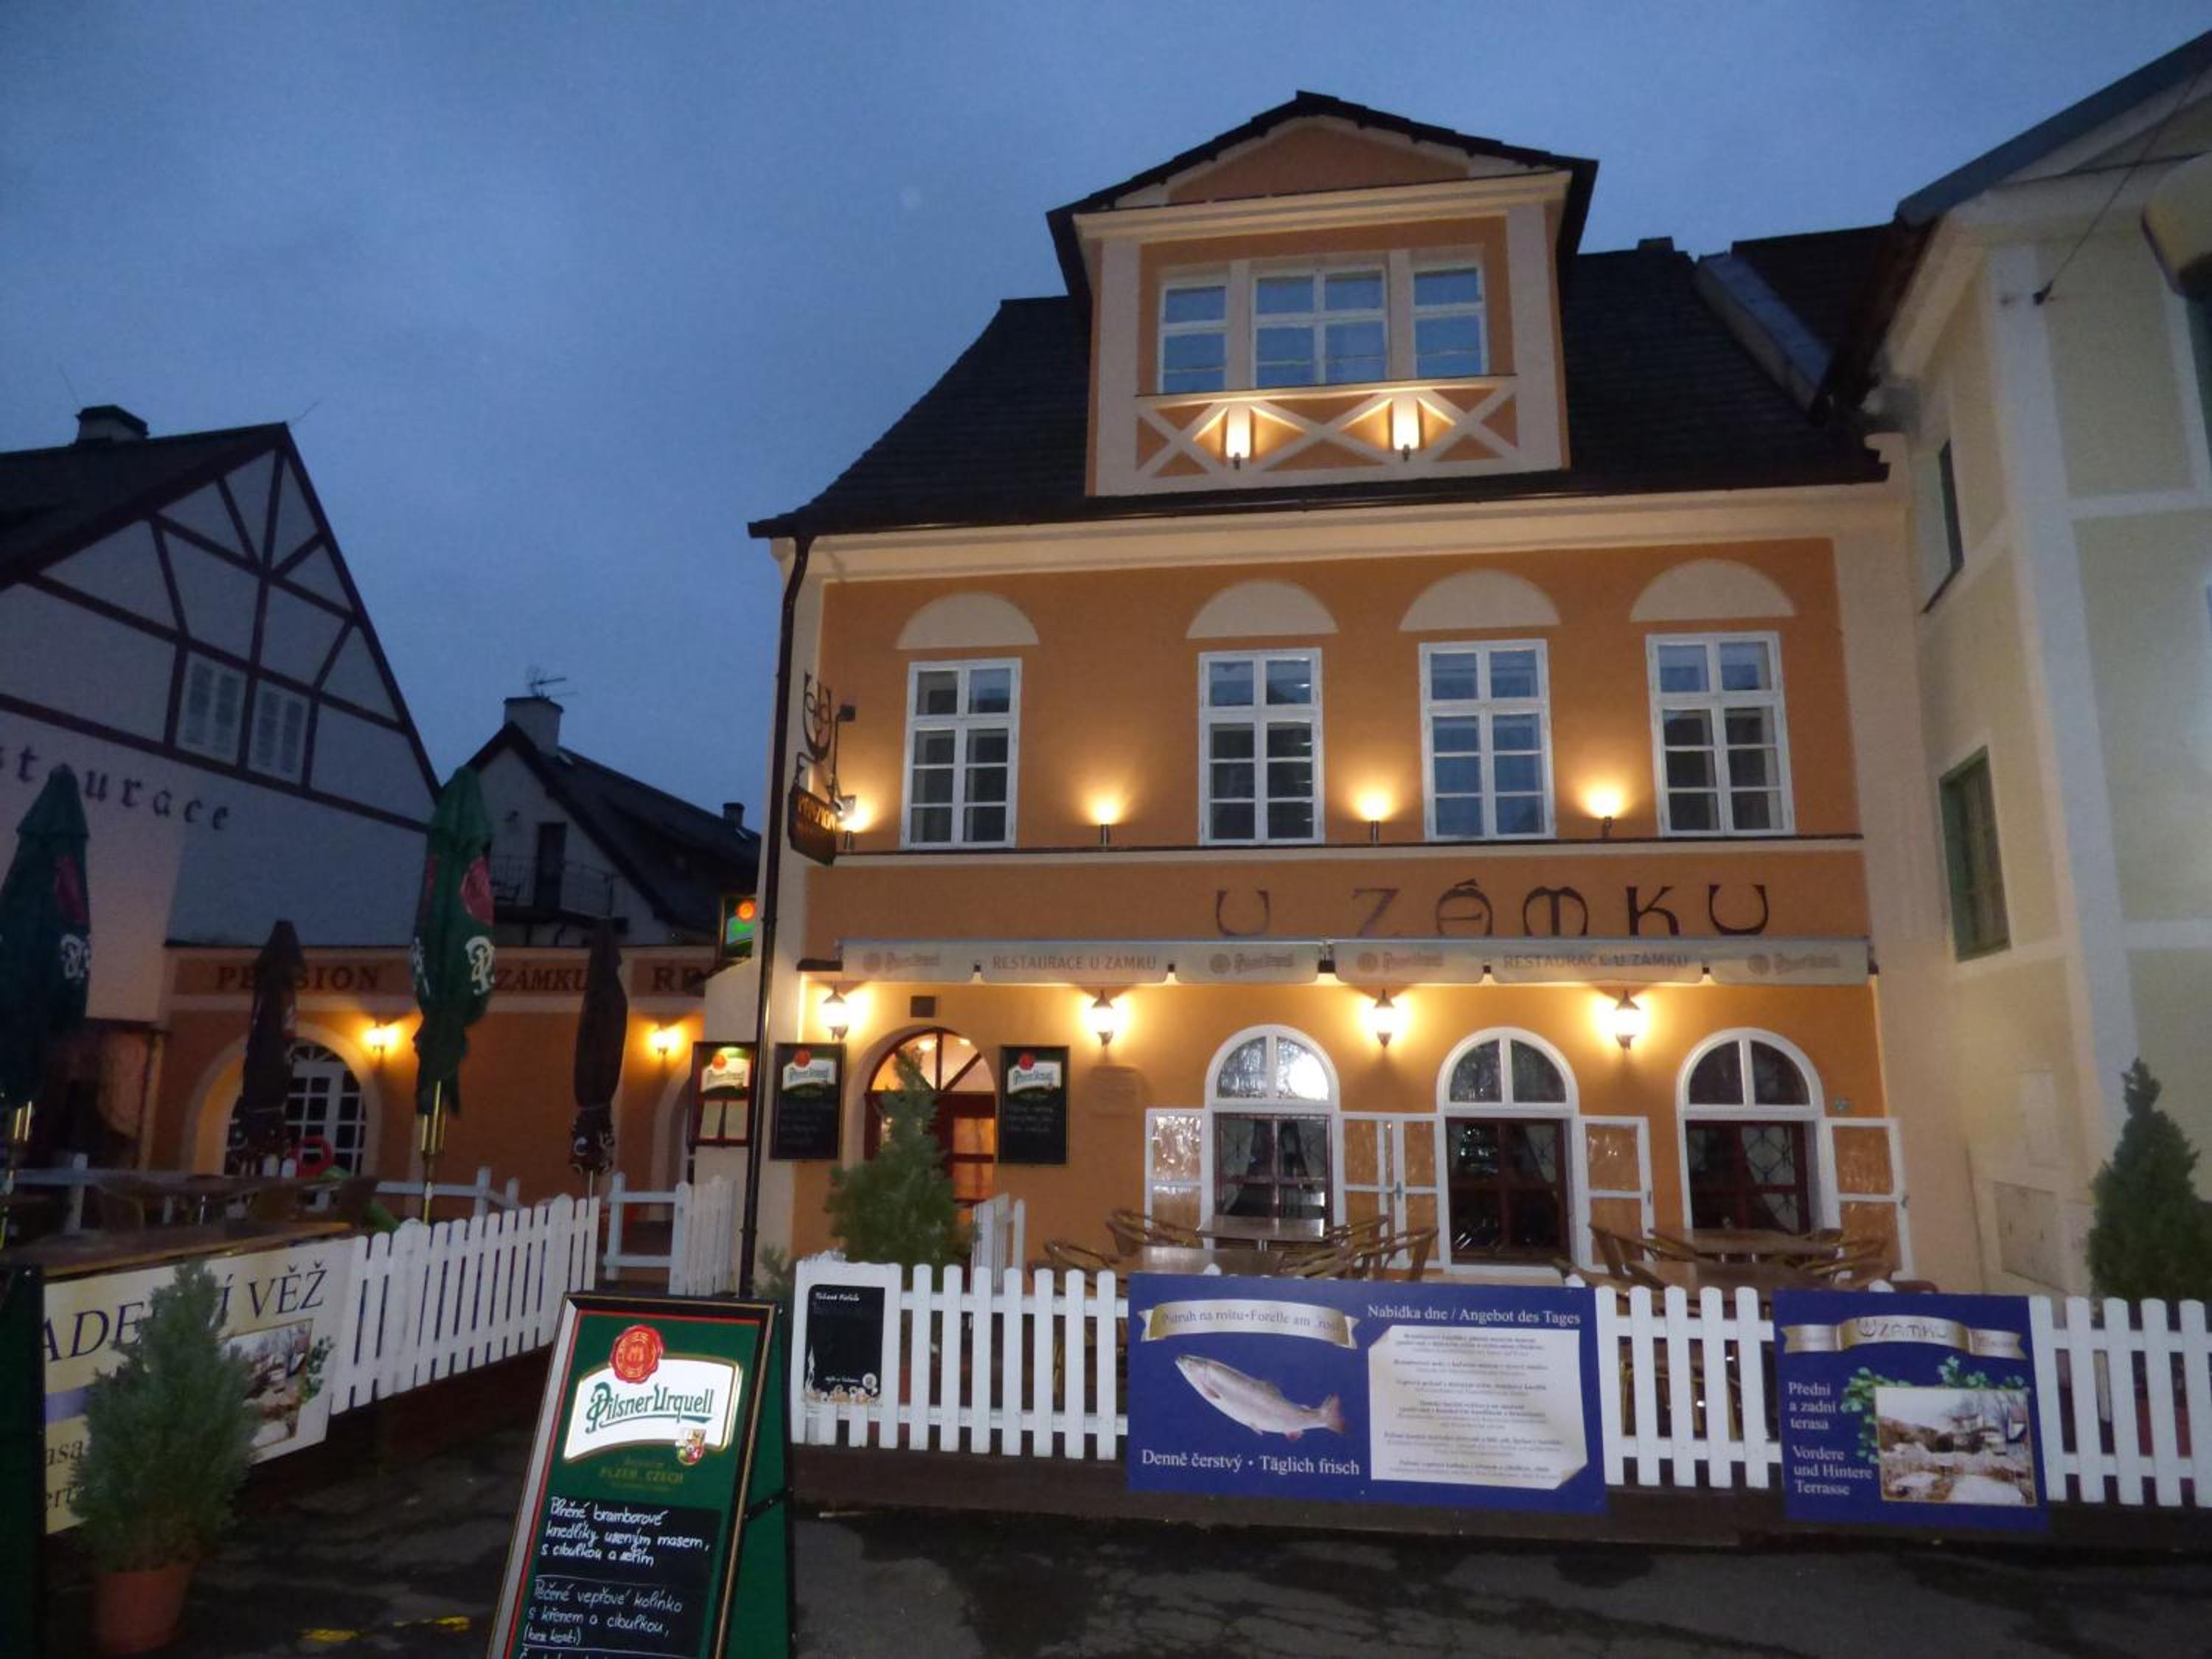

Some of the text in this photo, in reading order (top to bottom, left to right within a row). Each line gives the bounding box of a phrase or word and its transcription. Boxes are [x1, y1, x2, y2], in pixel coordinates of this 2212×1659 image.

[0, 746, 228, 830] turace
[1216, 889, 1269, 936] U
[992, 955, 1084, 970] RESTAURACE
[1091, 955, 1099, 970] U
[215, 966, 379, 991] PESION
[248, 1261, 327, 1318] VĚŽ
[1425, 1307, 1447, 1321] dne
[1459, 1309, 1514, 1325] Angebot
[1518, 1310, 1539, 1323] des
[1544, 1310, 1581, 1326] Tages
[585, 1382, 715, 1434] Pilsner Urquell
[1789, 1403, 1797, 1413] a
[1791, 1418, 1829, 1430] terasa
[1142, 1449, 1360, 1475] Denně čerstvý Täglich frisch
[1792, 1445, 1845, 1461] Vordere
[1794, 1464, 1873, 1480] und Hintere
[1795, 1479, 1851, 1496] Terrasse
[594, 1503, 669, 1526] bramborové
[540, 1543, 549, 1556] s
[608, 1550, 616, 1561] a
[657, 1536, 709, 1551] masem,
[528, 1607, 536, 1620] s
[589, 1614, 598, 1625] a
